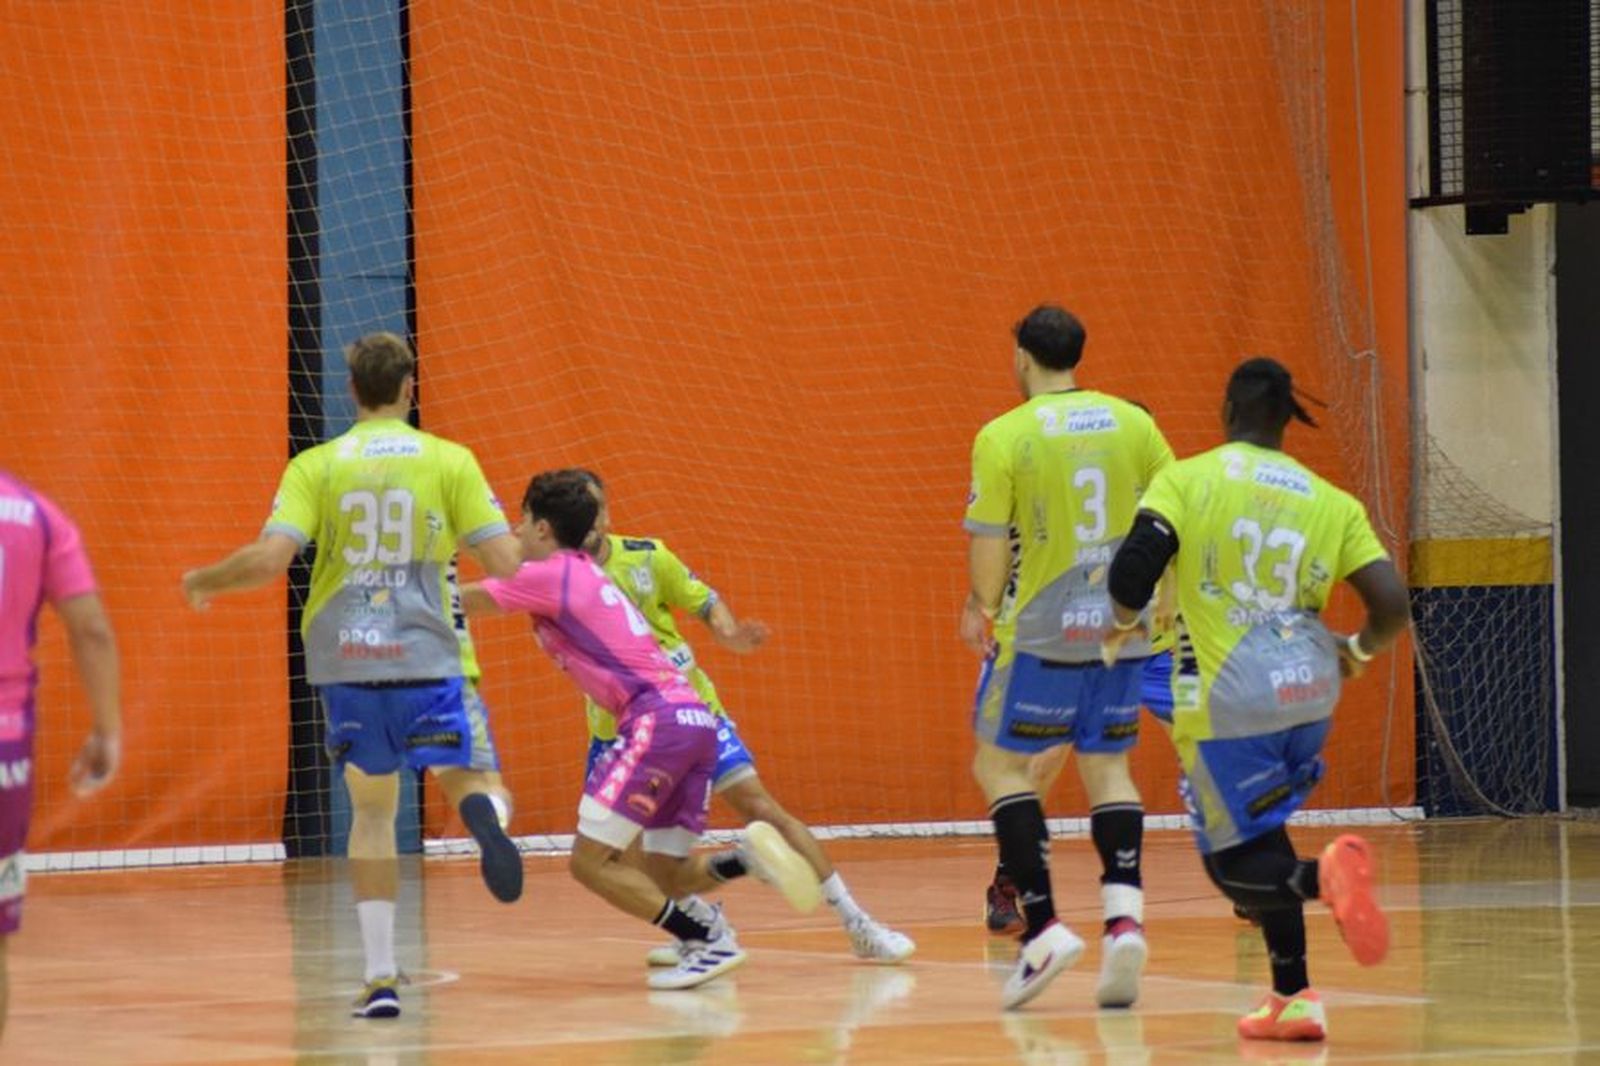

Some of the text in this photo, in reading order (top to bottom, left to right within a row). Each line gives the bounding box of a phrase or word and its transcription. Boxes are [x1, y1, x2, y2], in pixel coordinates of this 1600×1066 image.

[340, 489, 414, 566] 39
[1074, 467, 1107, 542] 3
[1062, 609, 1104, 629] PRO
[1269, 664, 1313, 690] PRO
